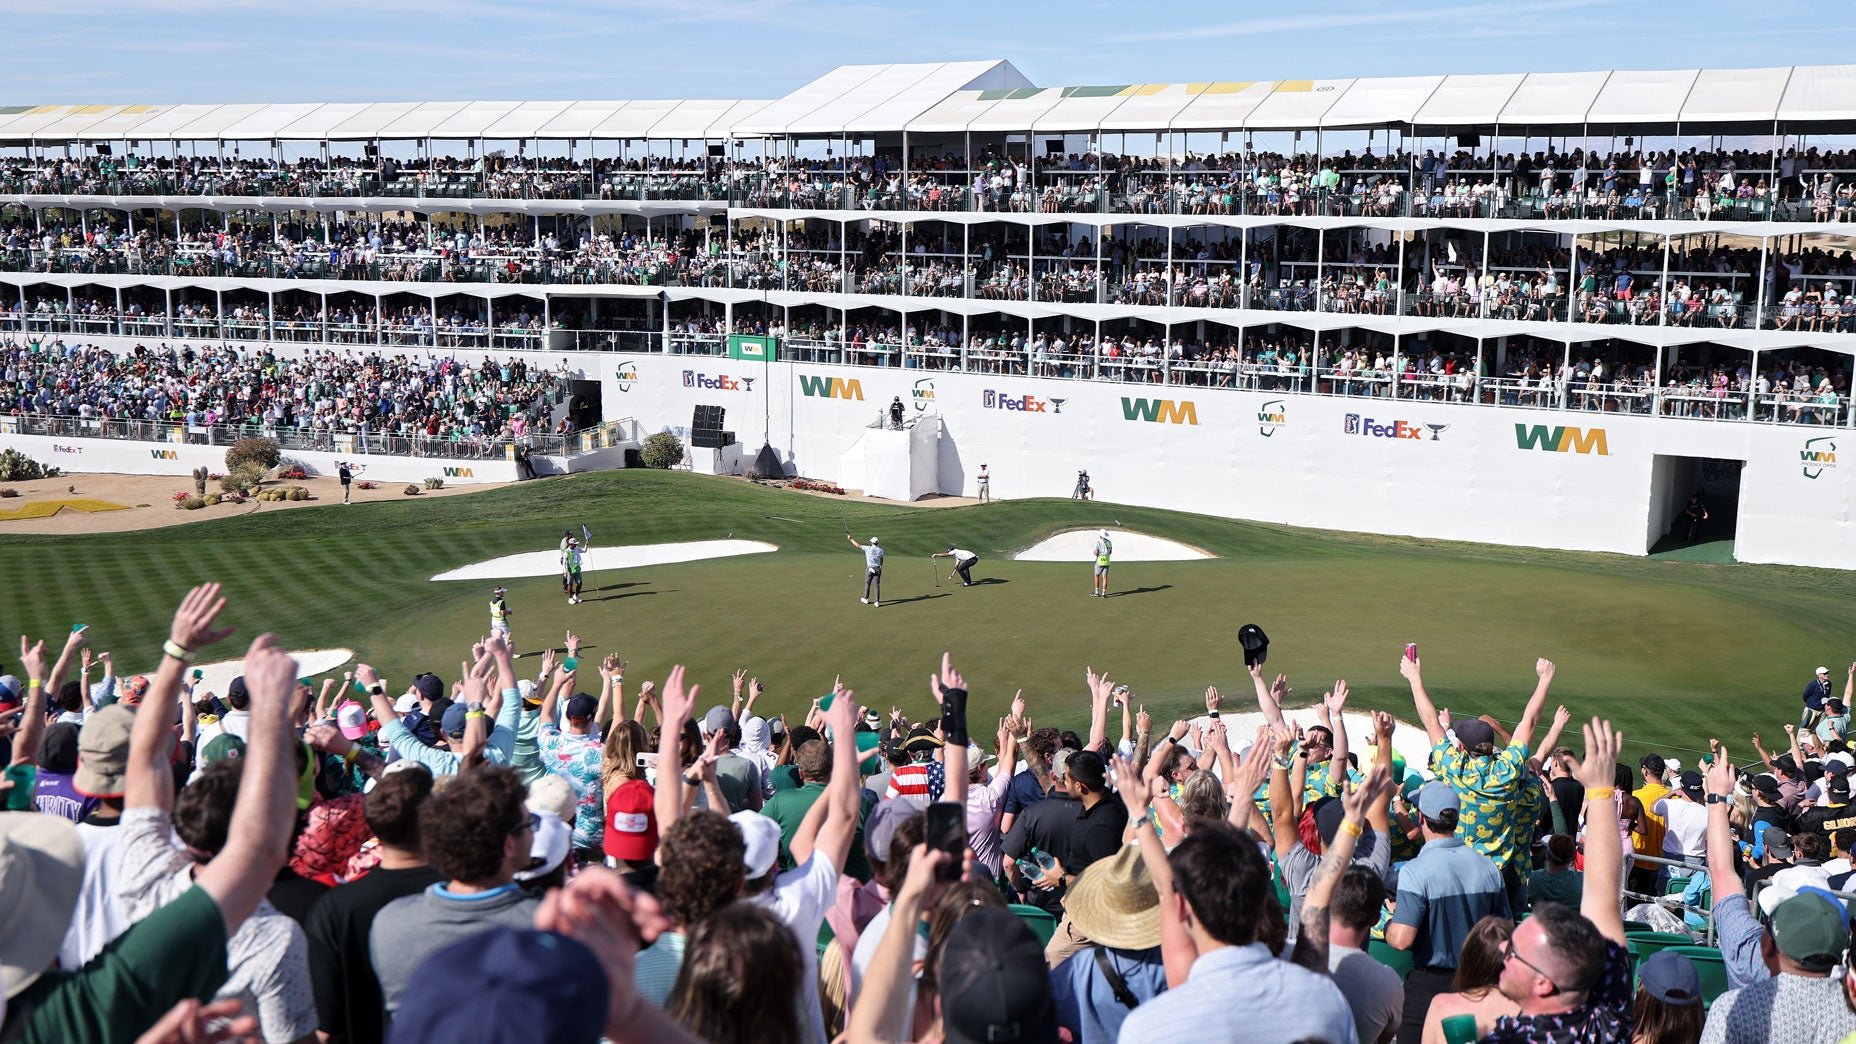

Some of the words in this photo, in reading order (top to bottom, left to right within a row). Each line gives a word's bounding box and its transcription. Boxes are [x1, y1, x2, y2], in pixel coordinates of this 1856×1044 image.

[744, 345, 760, 353] WM
[616, 371, 638, 380] WM
[697, 373, 740, 391] FedEx
[798, 374, 865, 401] WM
[912, 389, 935, 399] WM
[998, 393, 1047, 413] FedEx
[1120, 396, 1199, 426] WM
[1257, 412, 1285, 423] WM
[1363, 418, 1422, 440] FedEx
[1514, 423, 1609, 456] WM
[151, 449, 179, 461] WM
[1799, 450, 1836, 463] WM
[443, 466, 474, 478] WM
